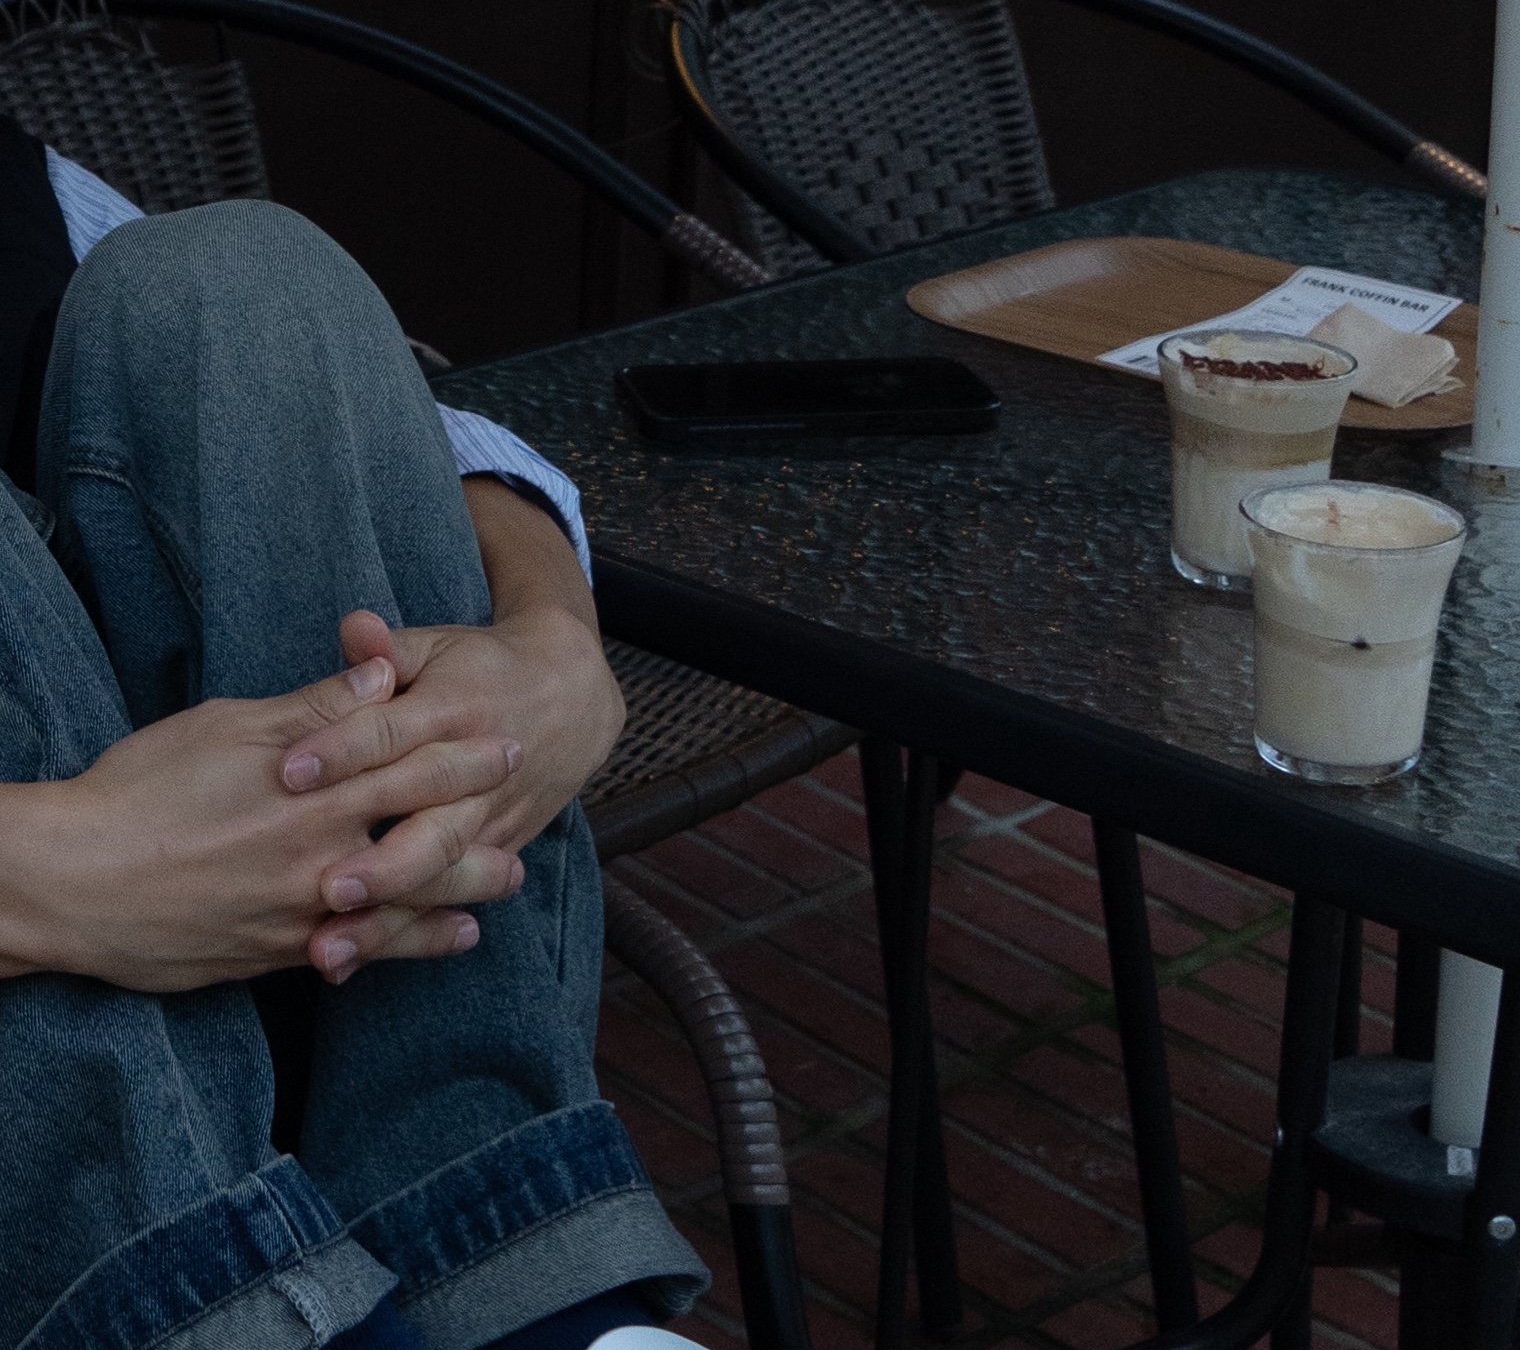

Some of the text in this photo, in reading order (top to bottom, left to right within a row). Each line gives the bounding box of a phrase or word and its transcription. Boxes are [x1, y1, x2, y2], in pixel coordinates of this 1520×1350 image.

[1302, 277, 1430, 313] FRANK COFFIN BAR
